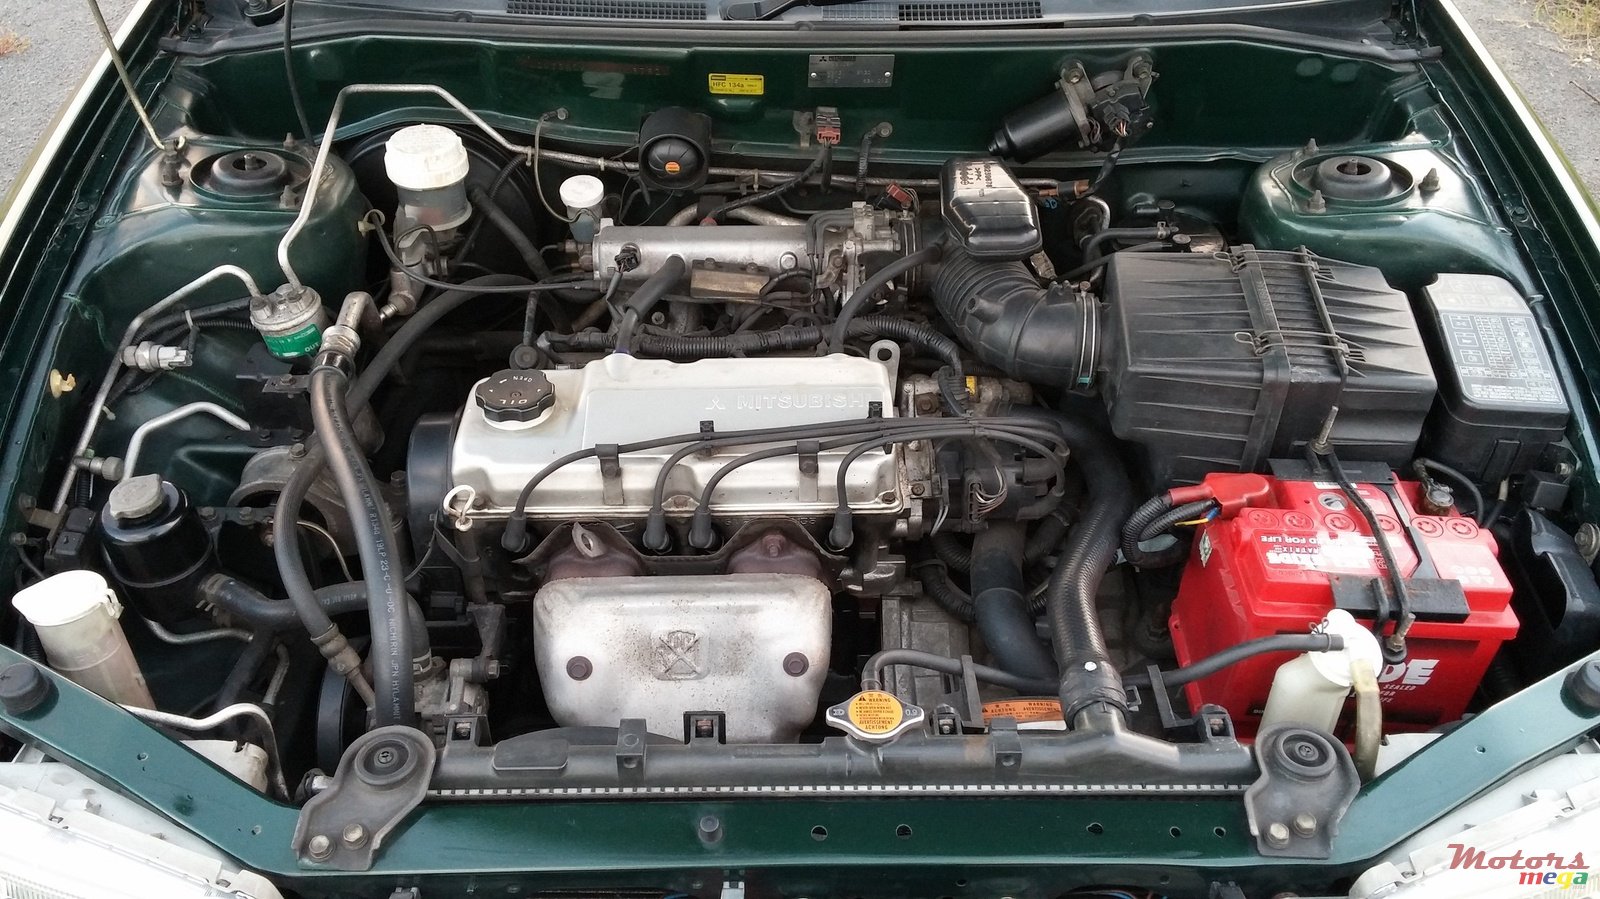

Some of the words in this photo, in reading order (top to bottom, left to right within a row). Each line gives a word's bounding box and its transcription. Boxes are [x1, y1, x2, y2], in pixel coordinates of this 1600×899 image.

[304, 342, 320, 353] OUT
[512, 375, 533, 383] OPEN
[737, 393, 872, 410] MITSUBISHI
[1260, 535, 1282, 543] LIFE
[1284, 536, 1307, 544] FOR
[1282, 546, 1319, 554] MATRIX
[388, 618, 399, 656] NICHIRIN
[391, 659, 400, 677] JPN
